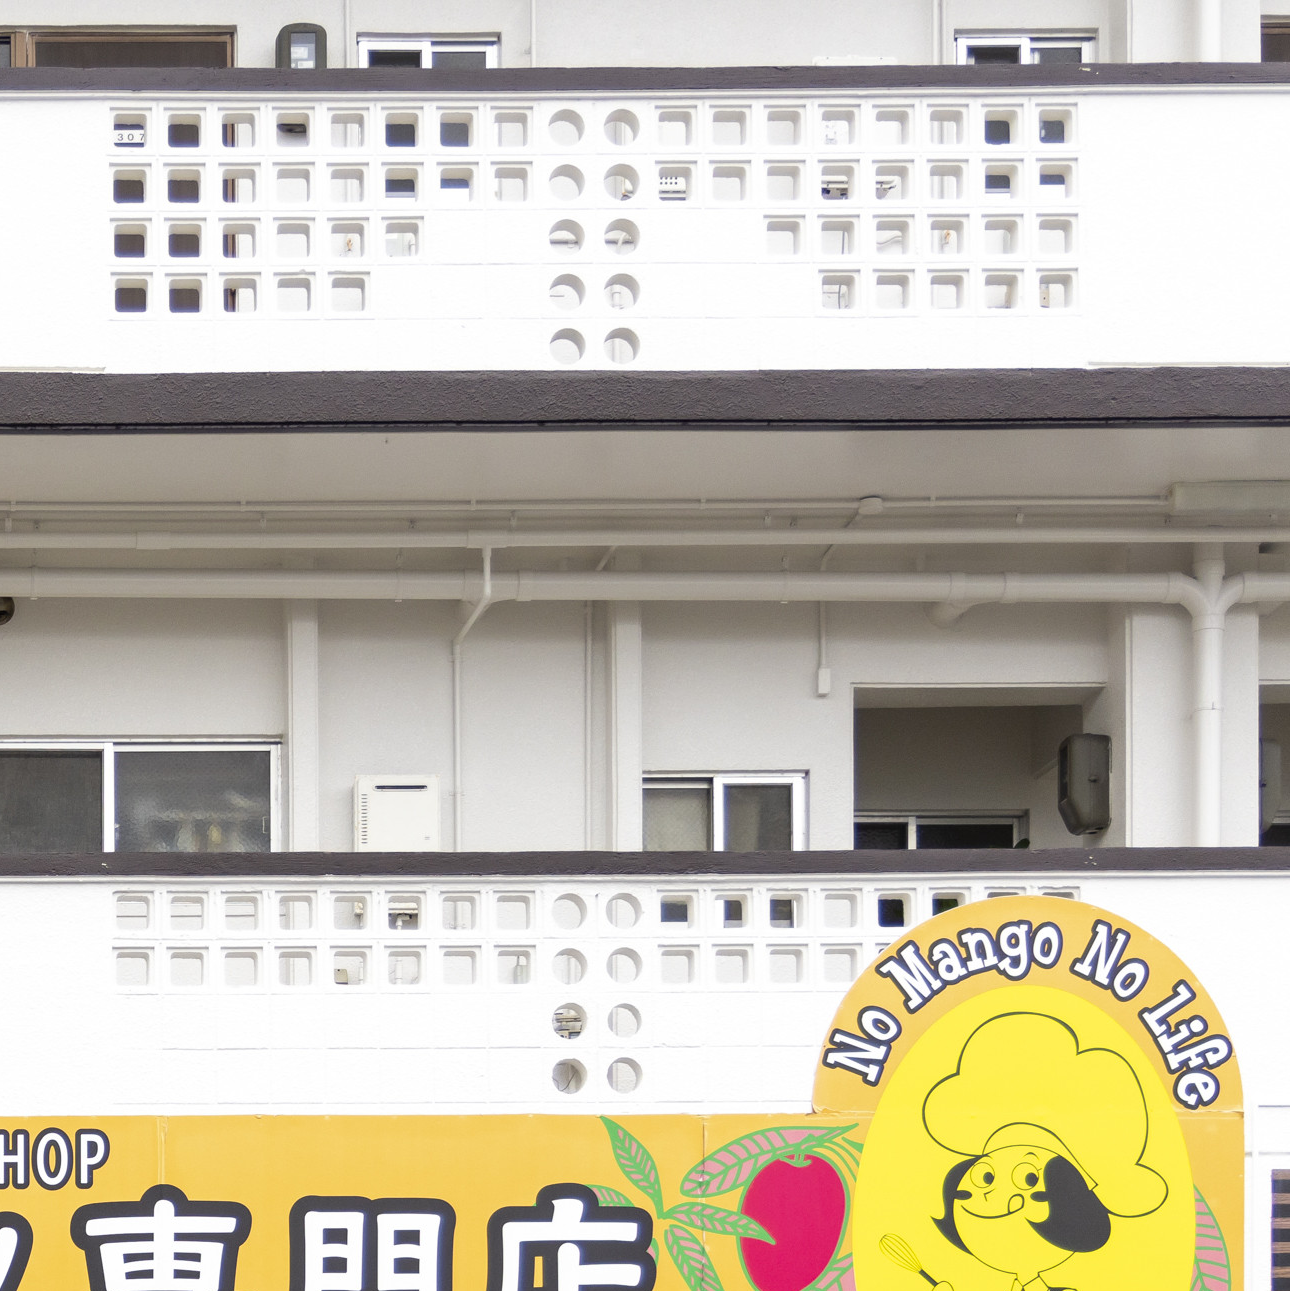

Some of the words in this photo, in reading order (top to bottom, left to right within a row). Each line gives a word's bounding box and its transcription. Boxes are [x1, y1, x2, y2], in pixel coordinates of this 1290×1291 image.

[117, 133, 145, 142] 307
[823, 1006, 902, 1085] No
[879, 920, 1063, 1011] Mango
[1072, 919, 1150, 1002] No
[1141, 981, 1232, 1110] Life
